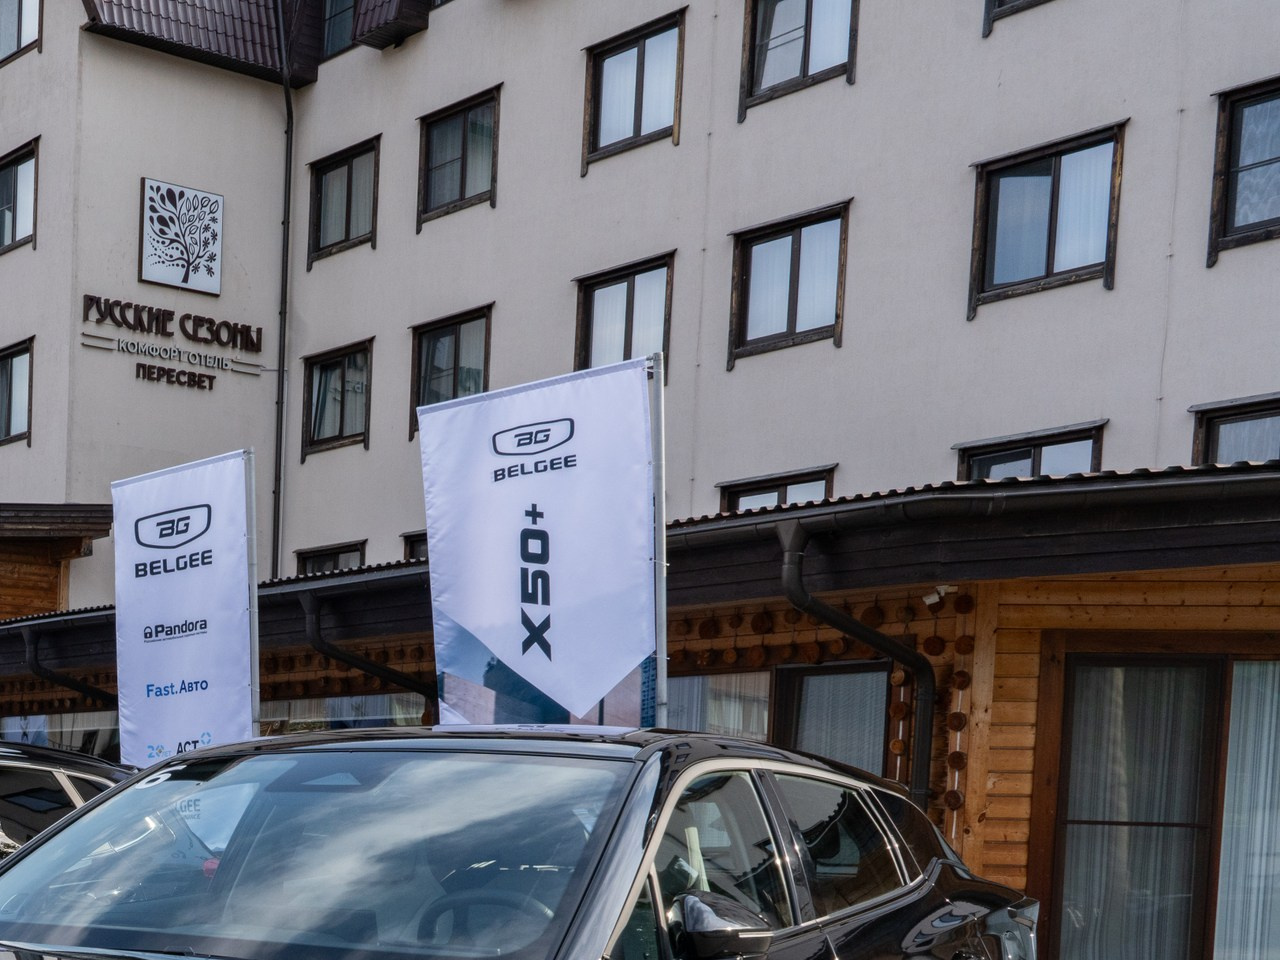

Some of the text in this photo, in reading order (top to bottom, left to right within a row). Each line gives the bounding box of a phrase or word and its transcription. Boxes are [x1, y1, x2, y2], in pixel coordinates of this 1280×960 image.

[83, 294, 263, 352] РУССКИЕ СЕЗОНЫ
[118, 339, 232, 370] КОМФОРТ ОТЕЛЬ
[136, 362, 216, 390] ПЕРЕСВЕТ
[493, 455, 577, 482] BELGEE
[135, 549, 213, 578] BELGEE
[520, 503, 552, 662] X50+
[154, 619, 208, 638] Pandora
